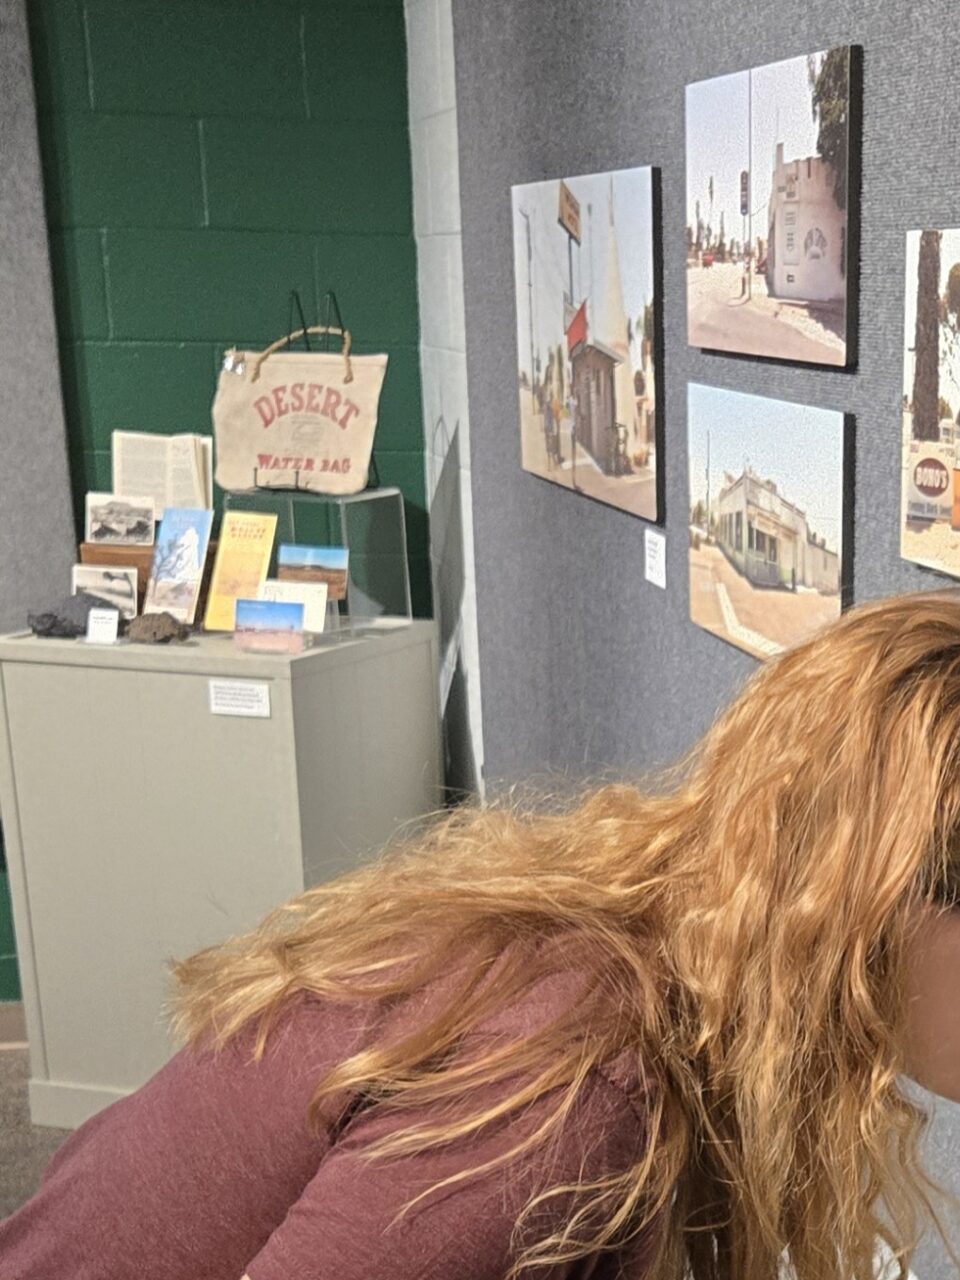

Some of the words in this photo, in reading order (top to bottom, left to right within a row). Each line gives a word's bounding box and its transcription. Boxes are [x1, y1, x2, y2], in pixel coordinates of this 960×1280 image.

[253, 383, 360, 429] DESERT
[257, 454, 315, 471] WATER
[320, 457, 351, 474] BAG
